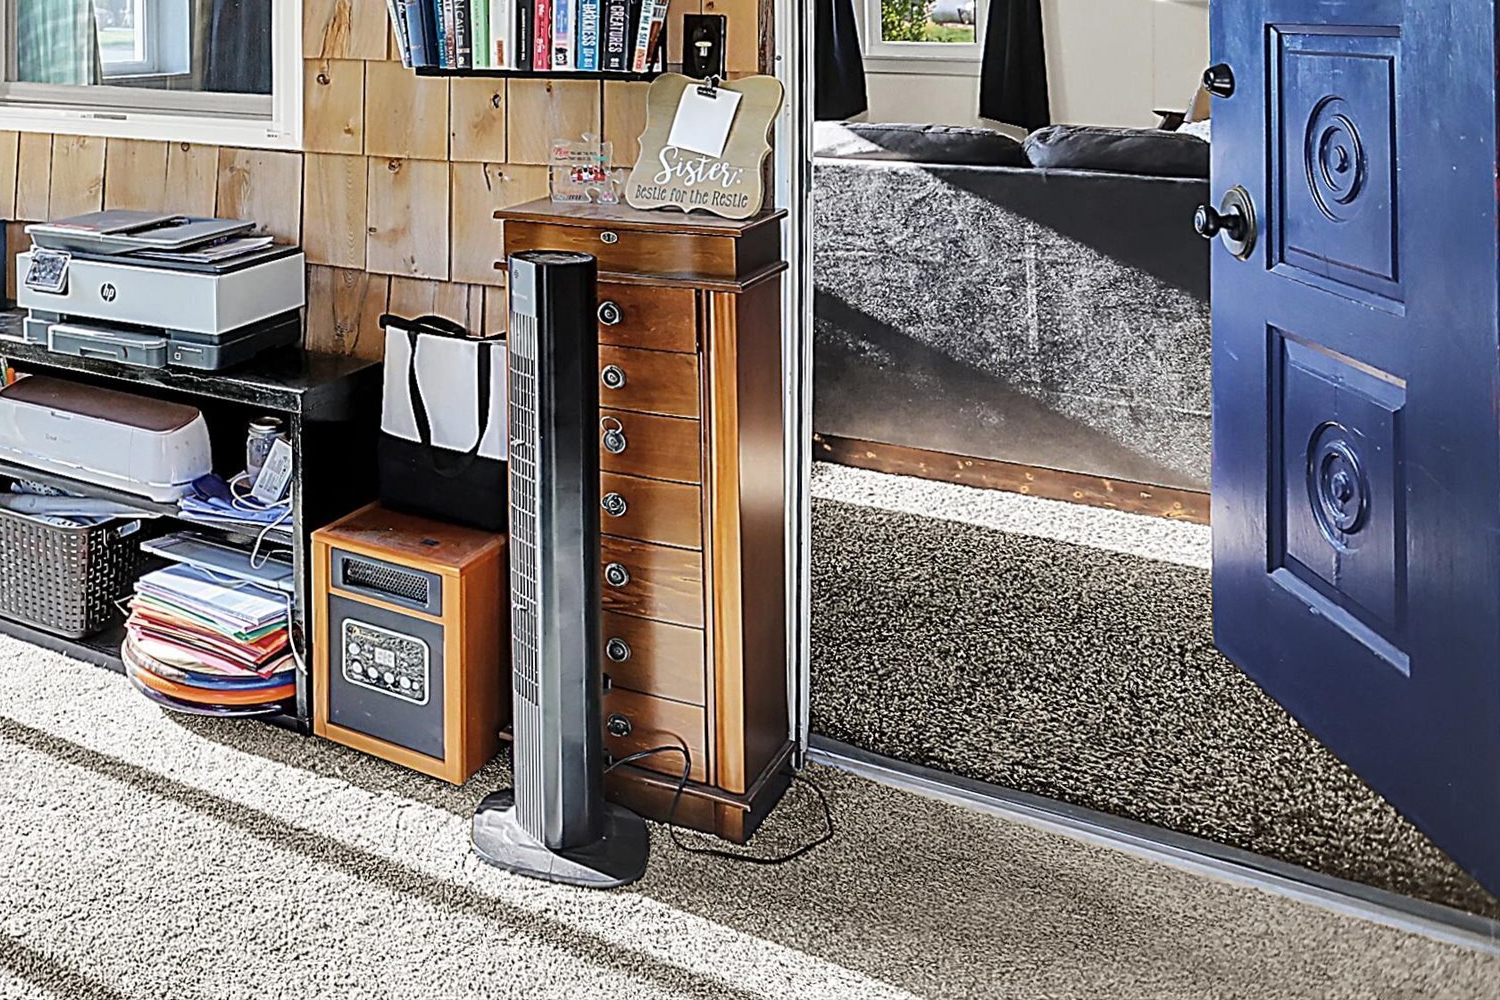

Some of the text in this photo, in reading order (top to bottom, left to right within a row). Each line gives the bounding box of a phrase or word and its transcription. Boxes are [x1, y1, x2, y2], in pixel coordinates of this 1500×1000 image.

[454, 10, 466, 34] CAST
[582, 3, 596, 46] DARKNESS
[609, 5, 624, 53] CREATURES
[642, 16, 650, 24] ME
[638, 33, 647, 47] SEAT
[654, 146, 744, 188] Sister:
[635, 185, 748, 208] Bestie for the Restie
[102, 283, 115, 302] hp
